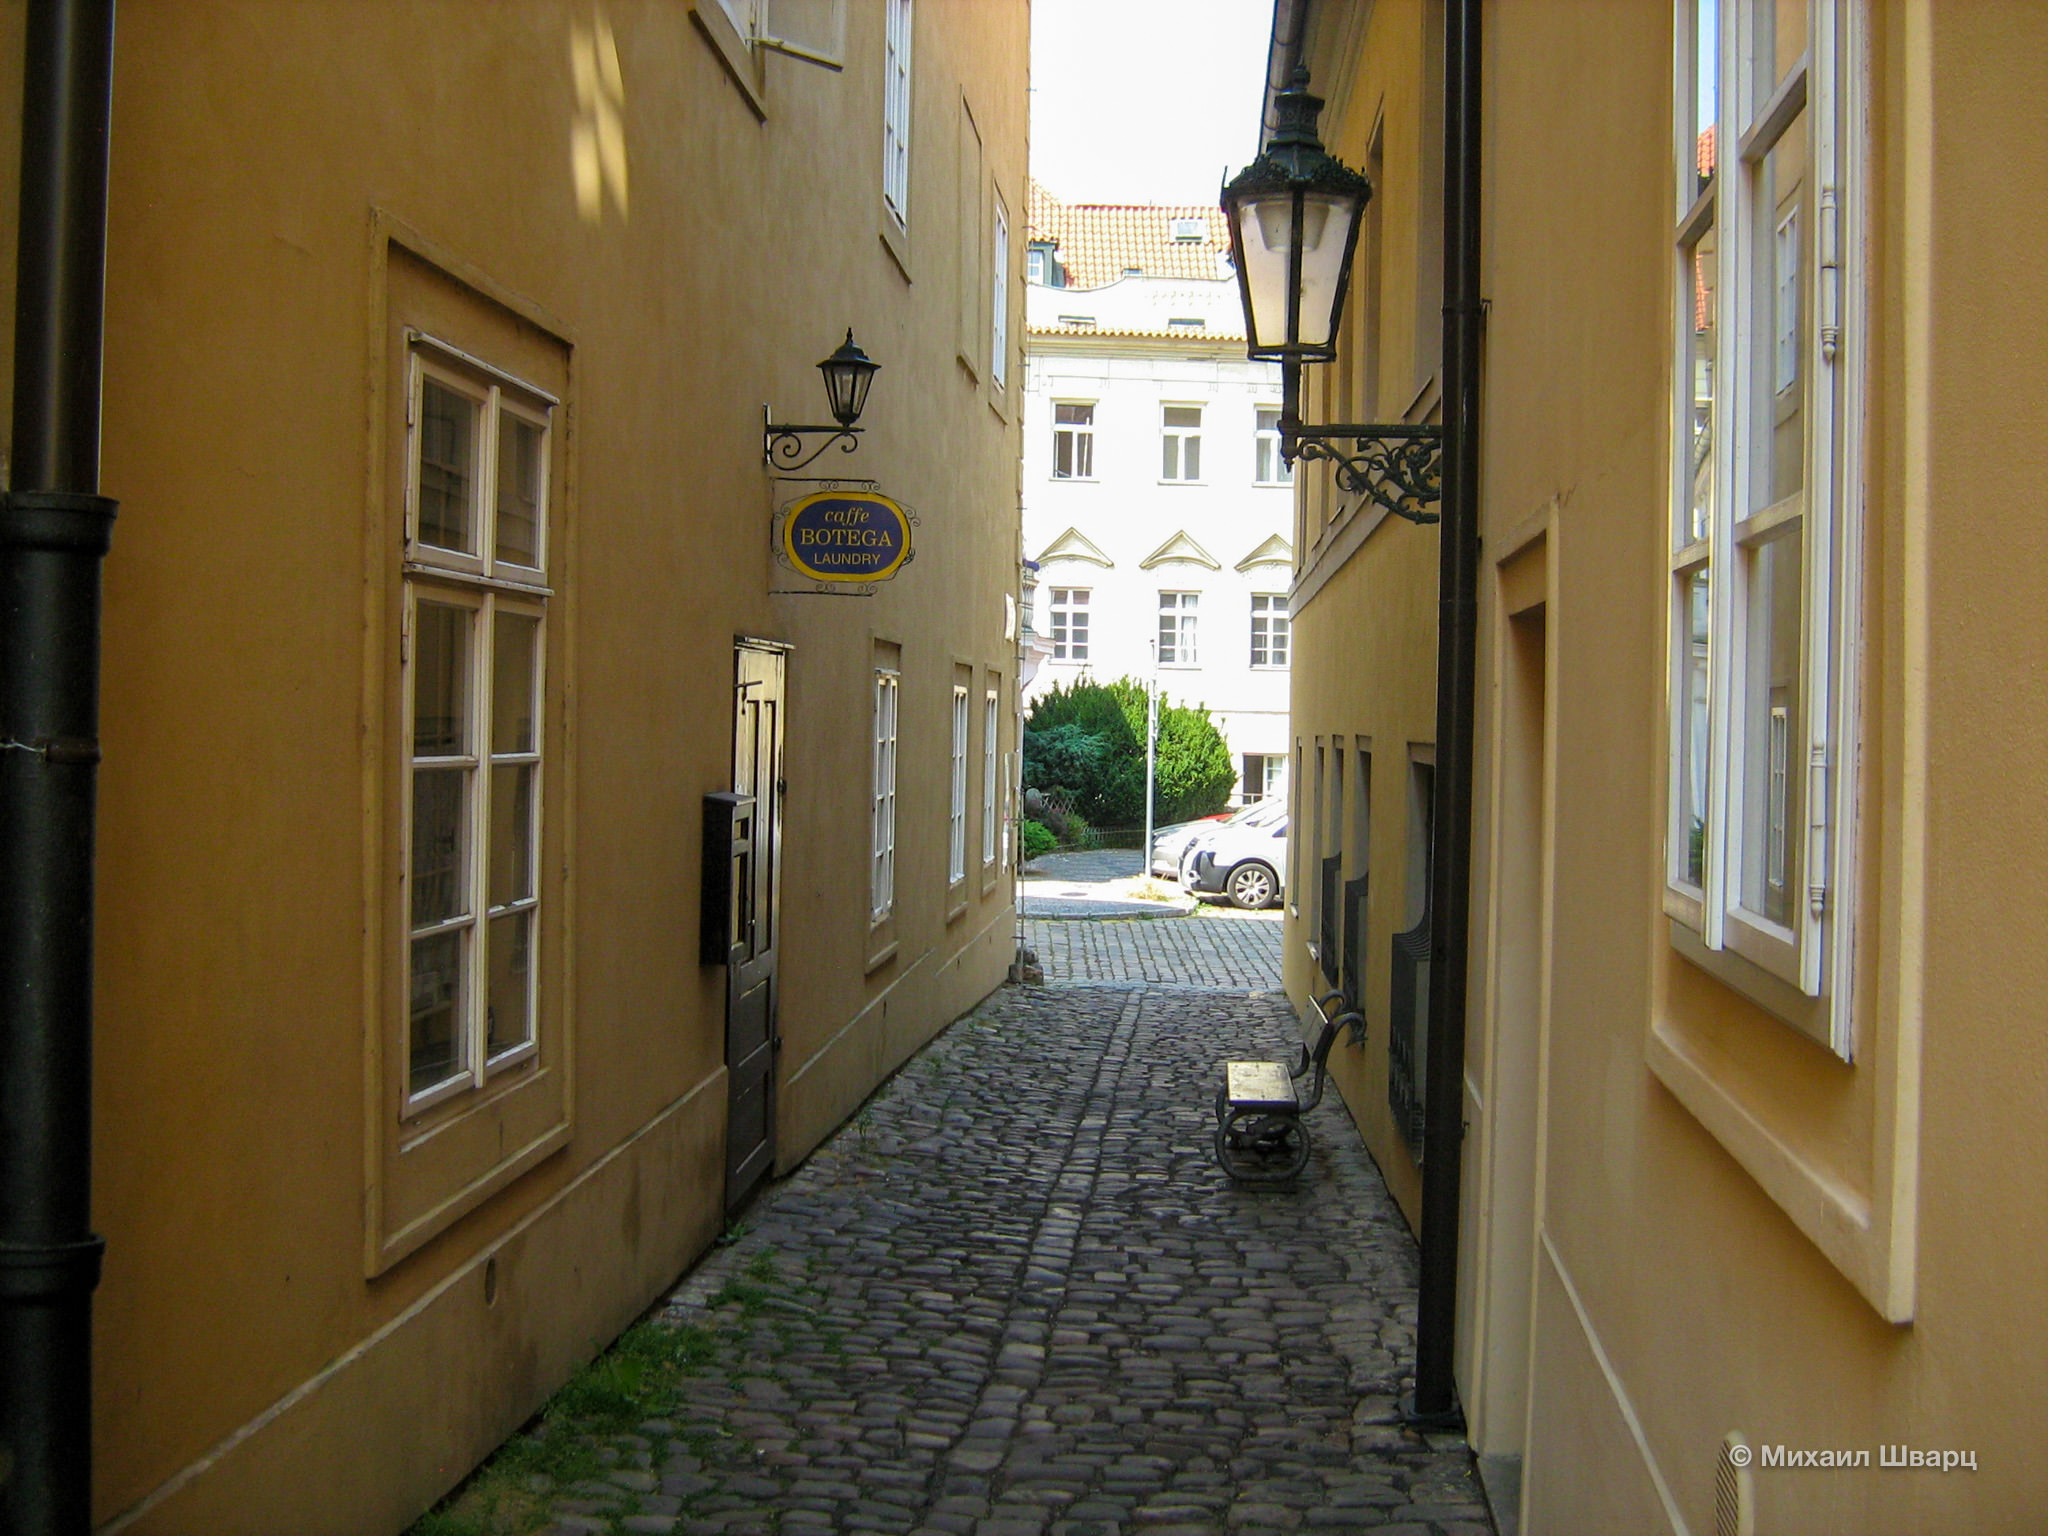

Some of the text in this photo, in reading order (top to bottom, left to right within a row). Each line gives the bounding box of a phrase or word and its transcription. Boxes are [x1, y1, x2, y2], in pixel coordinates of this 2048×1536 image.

[824, 506, 870, 526] caffe
[800, 528, 893, 547] BOTEGA
[814, 553, 881, 565] LAUNDRY
